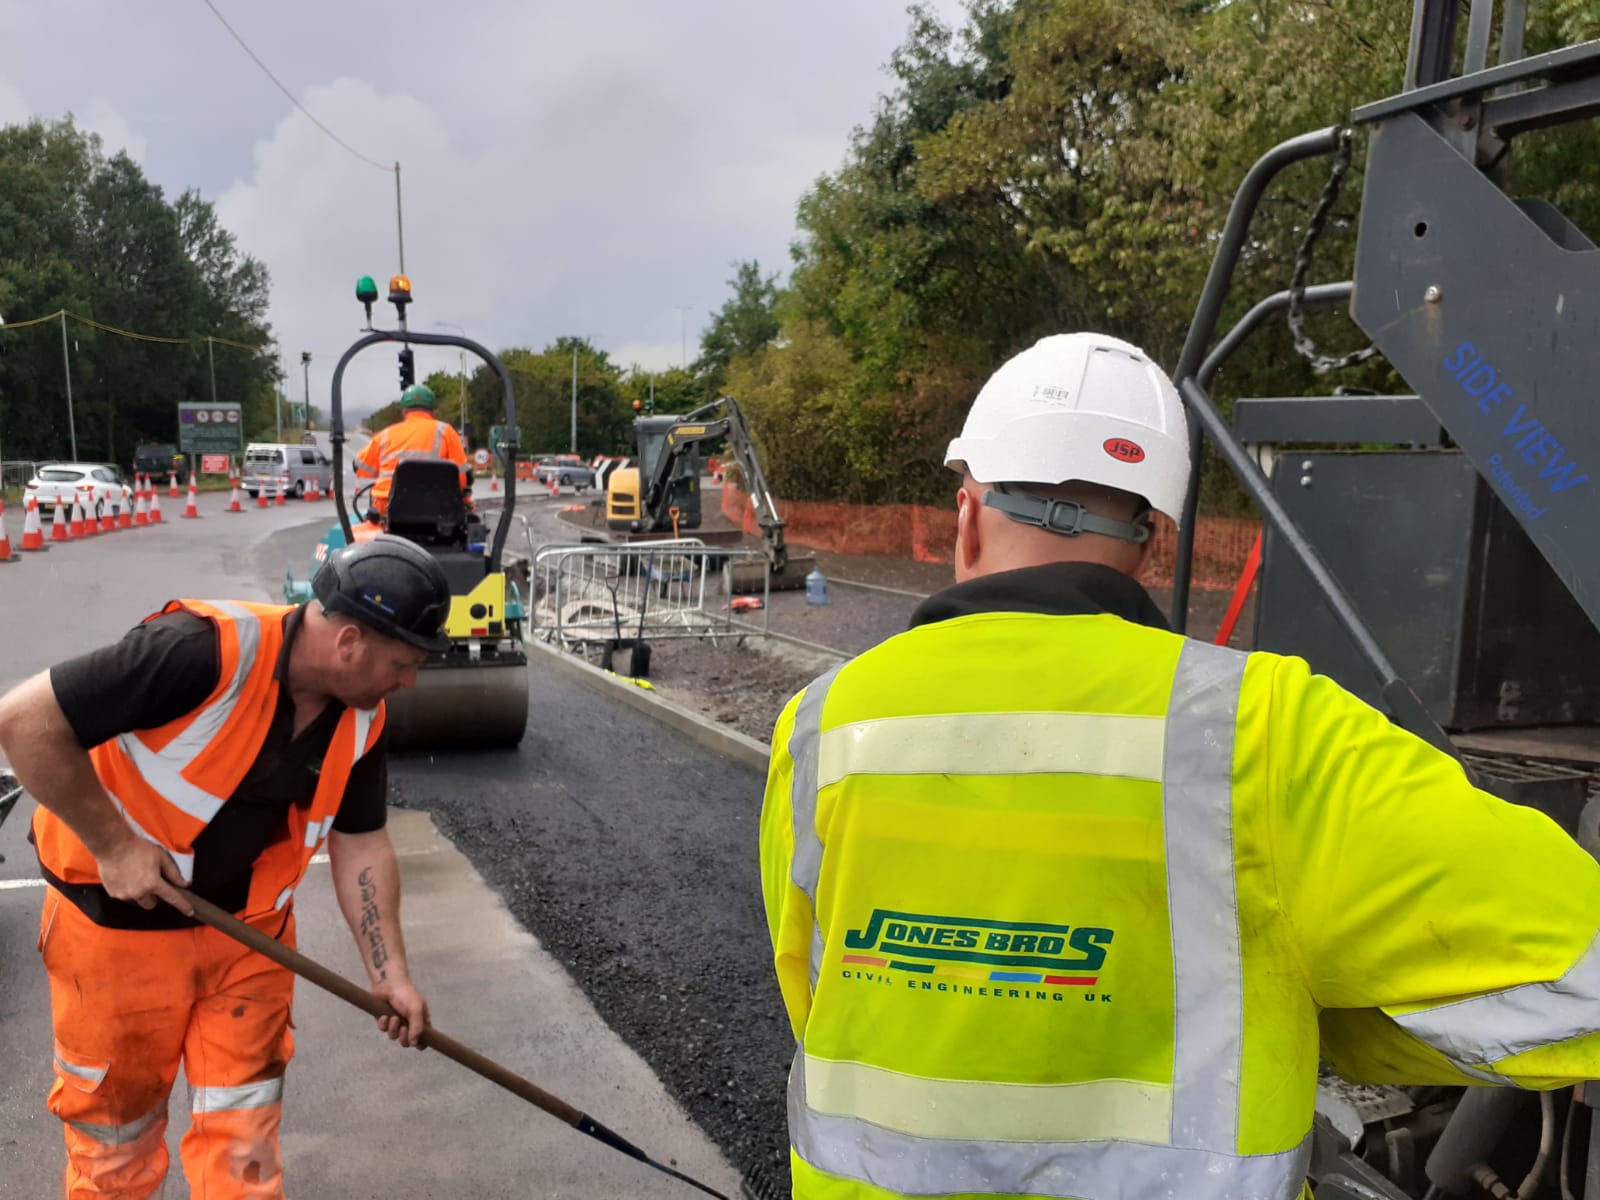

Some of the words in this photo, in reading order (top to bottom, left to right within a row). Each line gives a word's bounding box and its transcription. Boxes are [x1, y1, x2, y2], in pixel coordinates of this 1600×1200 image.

[1443, 342, 1514, 415] SIDE
[1503, 403, 1590, 493] VIEW
[1110, 442, 1140, 459] JSP
[844, 908, 980, 950] JONES
[842, 970, 893, 985] CIVIL
[908, 979, 1064, 1002] ENGINEERING
[1084, 993, 1112, 1002] UK
